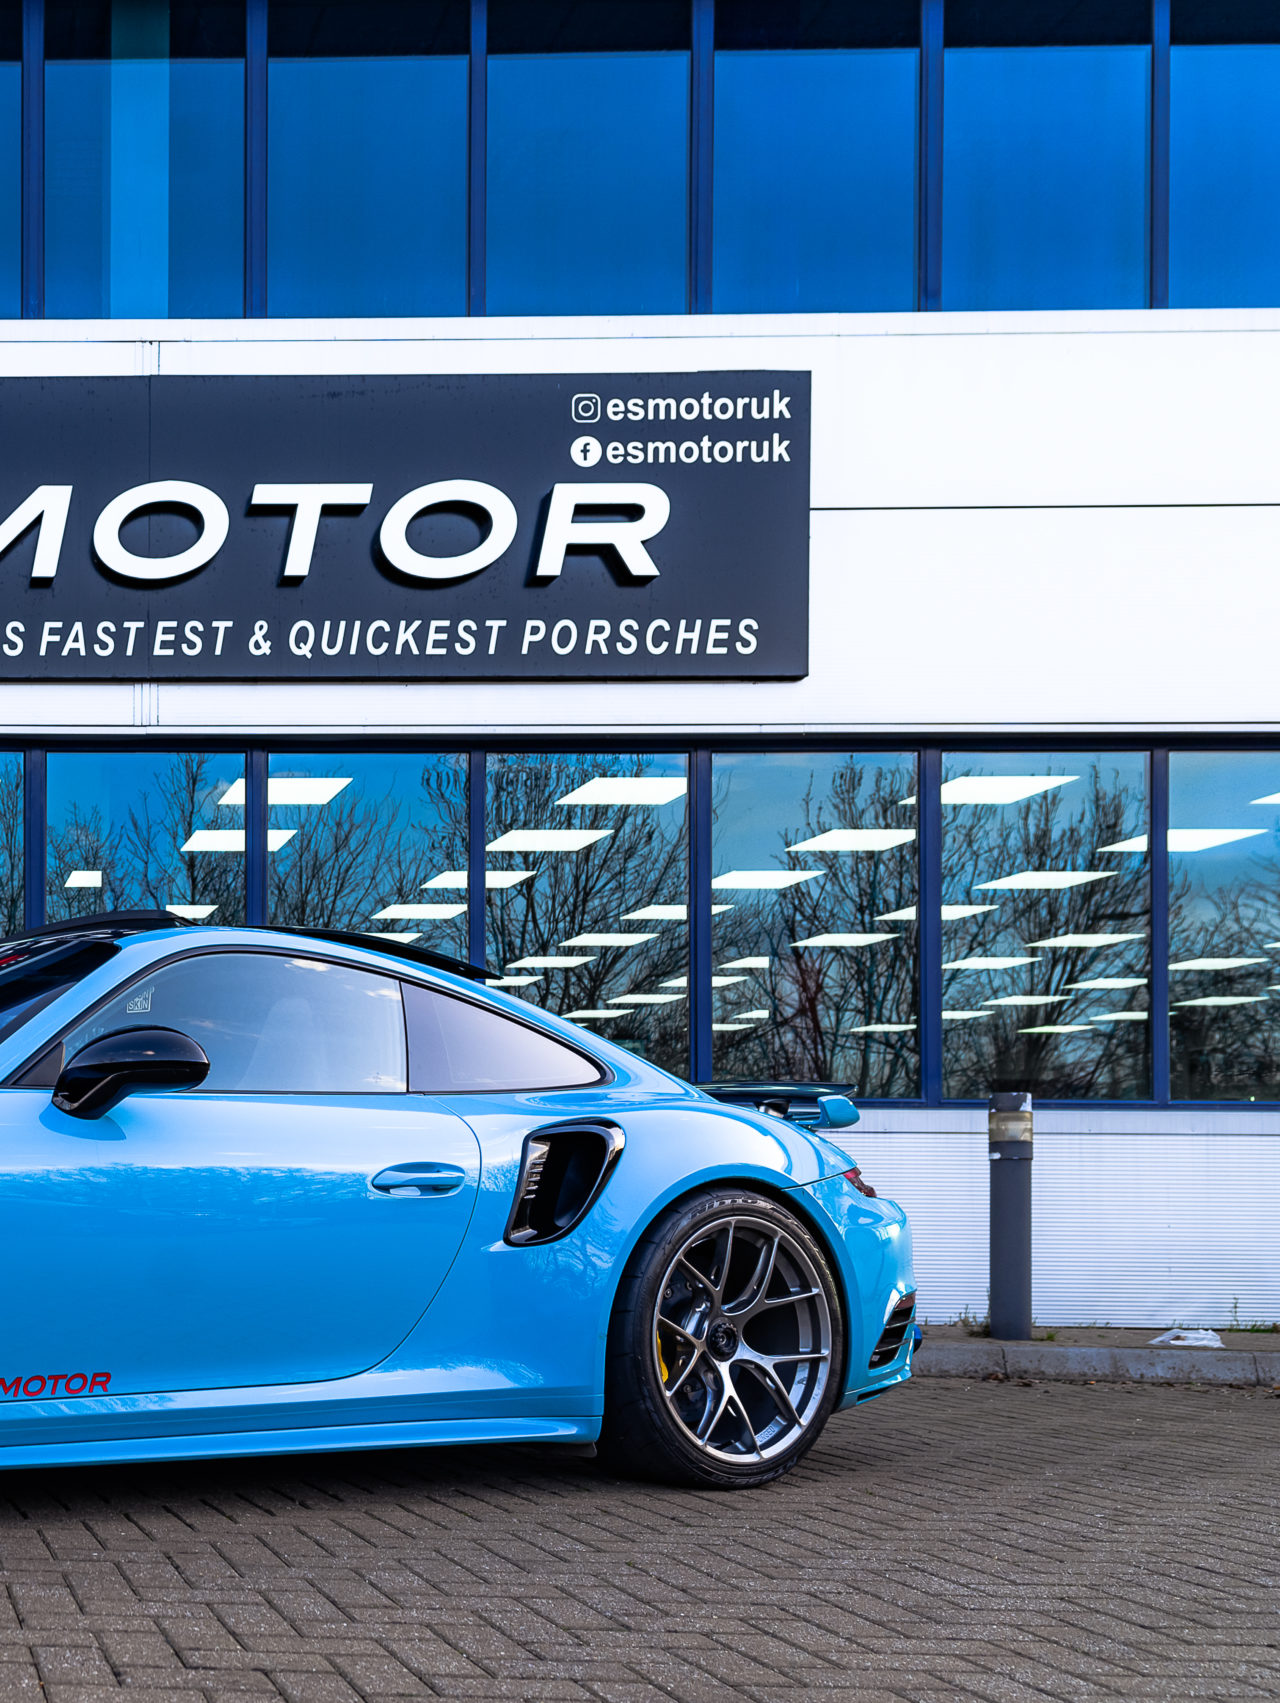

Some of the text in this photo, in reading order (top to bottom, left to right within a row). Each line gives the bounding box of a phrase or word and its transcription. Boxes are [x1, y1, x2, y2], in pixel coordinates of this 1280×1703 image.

[606, 389, 792, 421] esmotoruk
[606, 432, 791, 464] esmotoruk
[39, 620, 234, 657] FASTEST
[248, 620, 272, 656] &
[288, 619, 507, 659] QUICKEST
[521, 618, 759, 655] PORSCHES
